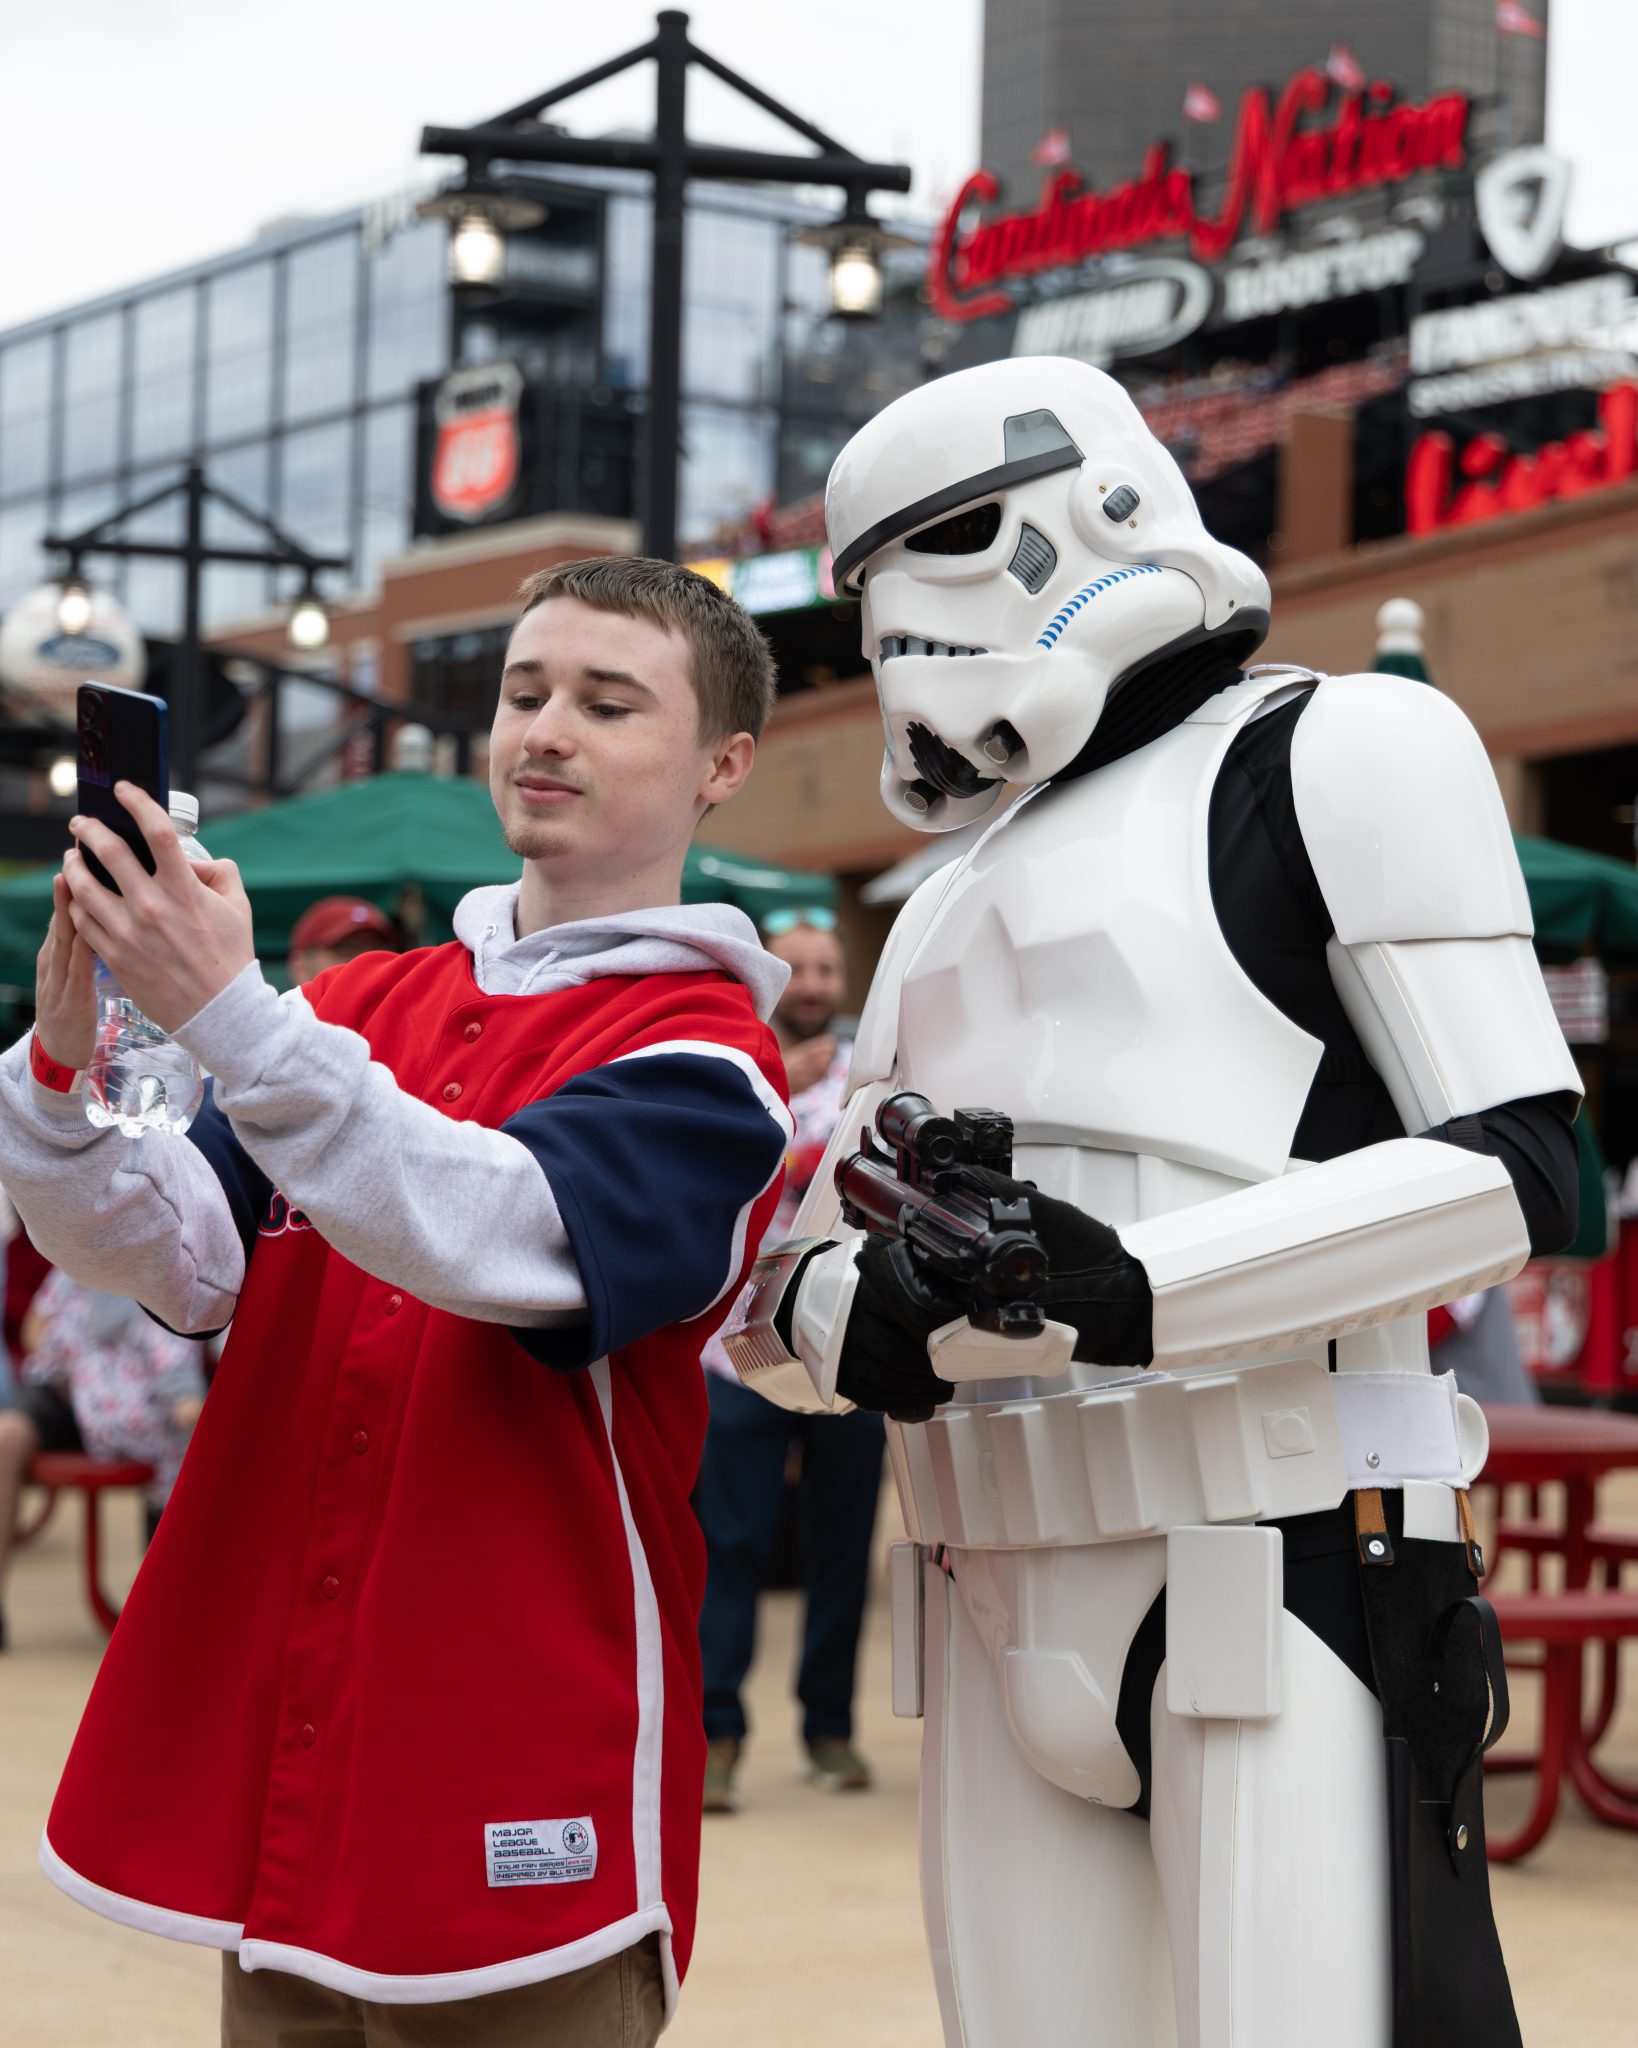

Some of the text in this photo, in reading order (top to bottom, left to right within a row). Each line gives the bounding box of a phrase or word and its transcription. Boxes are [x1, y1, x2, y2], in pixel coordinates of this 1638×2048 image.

[492, 1828, 533, 1838] MAJOR
[493, 1838, 539, 1848] LEAGUE
[494, 1847, 556, 1858] BASEBALL
[496, 1863, 520, 1871] TRUE
[521, 1862, 538, 1870] FAN
[496, 1871, 536, 1879] INSPIRED
